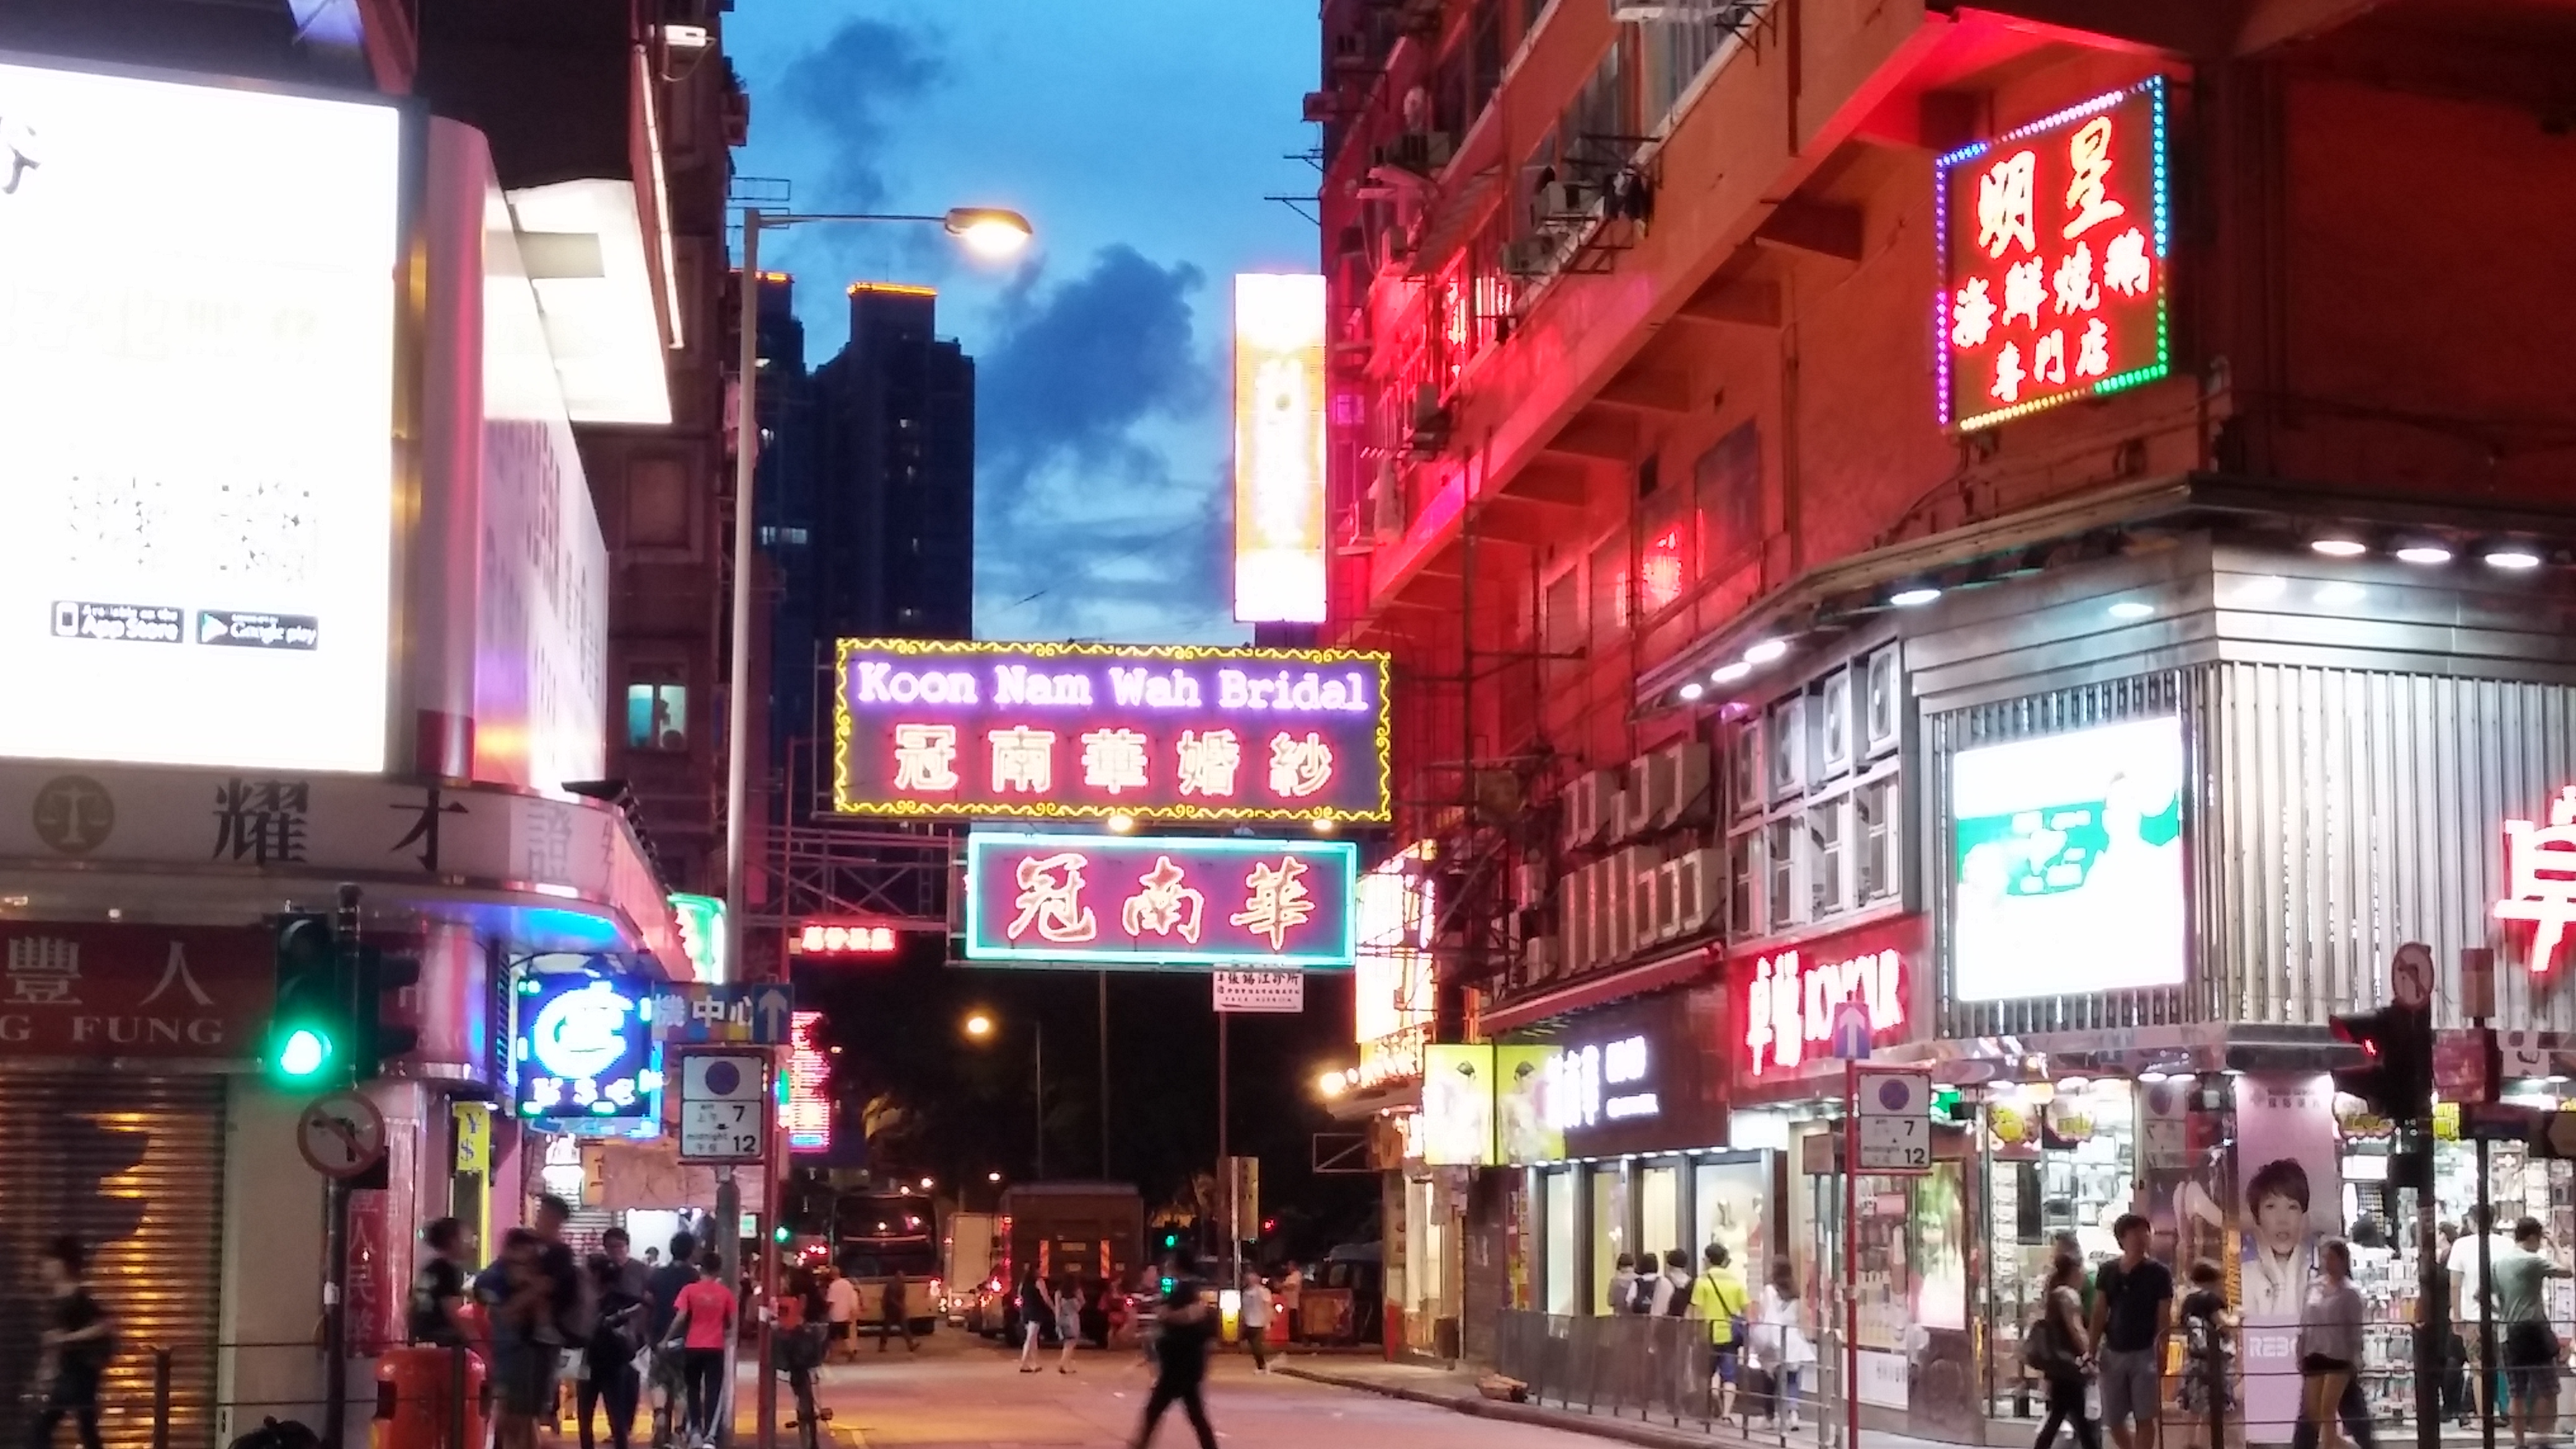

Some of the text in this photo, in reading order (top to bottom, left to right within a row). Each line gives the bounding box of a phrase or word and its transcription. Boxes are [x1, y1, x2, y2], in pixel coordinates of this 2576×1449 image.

[1977, 116, 2125, 259] 明星
[858, 661, 1369, 711] Koon Nam Wah Bridal
[893, 723, 1333, 797] 冠南華婚紗
[1007, 853, 1315, 951] 冠南華
[72, 1016, 223, 1044] FUNG
[733, 1105, 745, 1122] 7
[1904, 1120, 1915, 1136] 7
[733, 1134, 756, 1152] 12
[1905, 1148, 1925, 1164] 12
